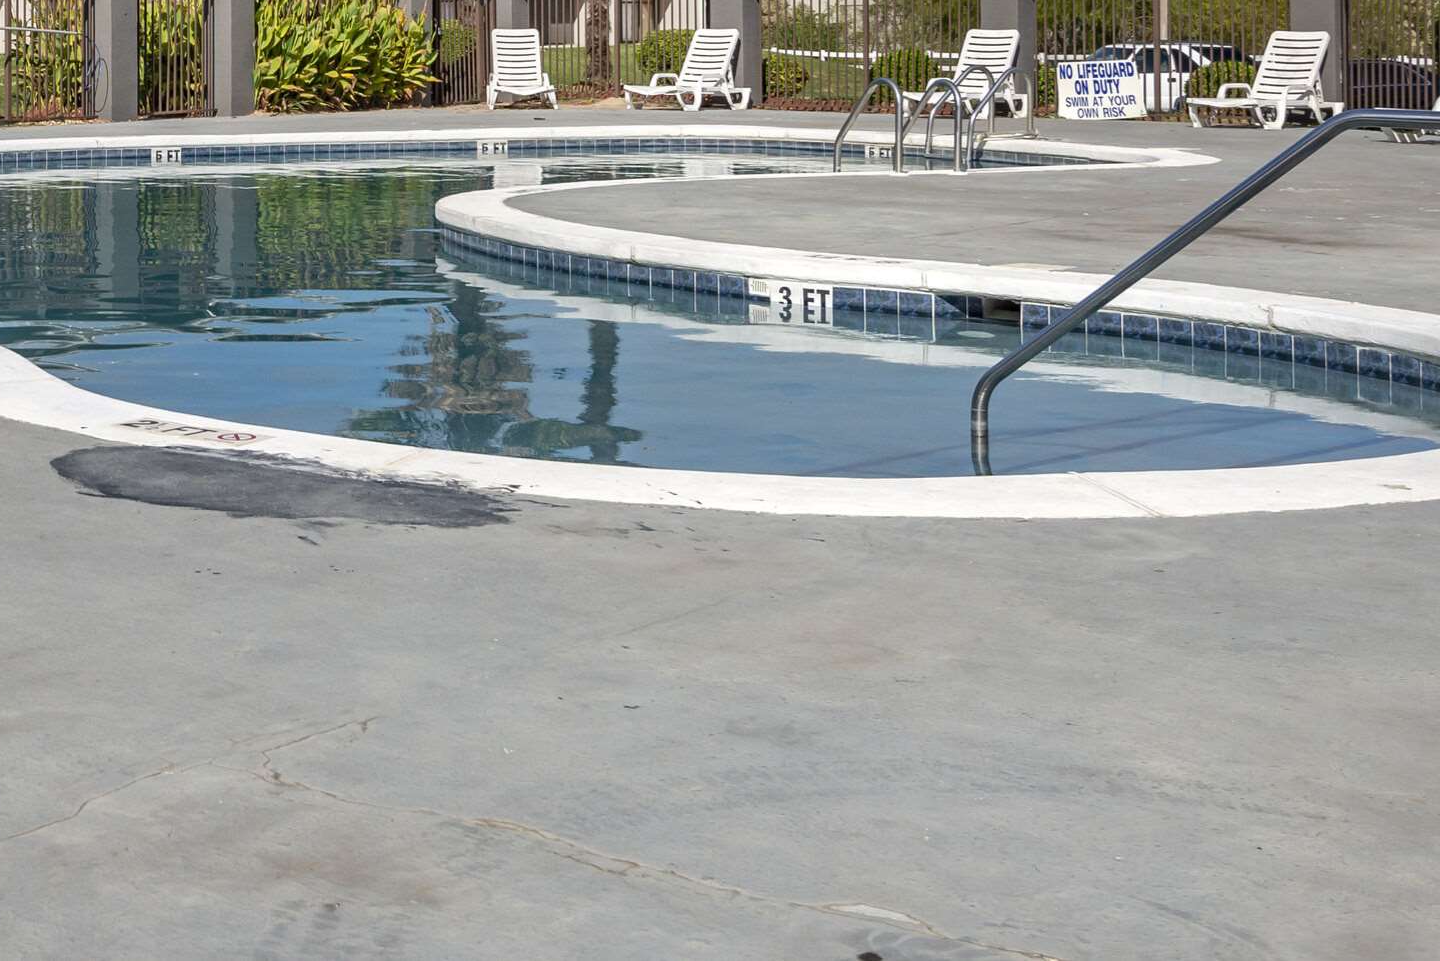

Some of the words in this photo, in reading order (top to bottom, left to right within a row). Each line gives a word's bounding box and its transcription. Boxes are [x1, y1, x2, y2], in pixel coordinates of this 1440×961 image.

[1059, 64, 1072, 79] NO
[1077, 62, 1134, 79] LIFEGUARD
[1074, 80, 1089, 95] ON
[1093, 79, 1120, 95] DUTY
[1065, 97, 1088, 107] SWIM
[1092, 96, 1103, 106] AT
[1108, 95, 1136, 106] YOUR
[1077, 108, 1099, 118] OWN
[1103, 107, 1126, 118] RISK
